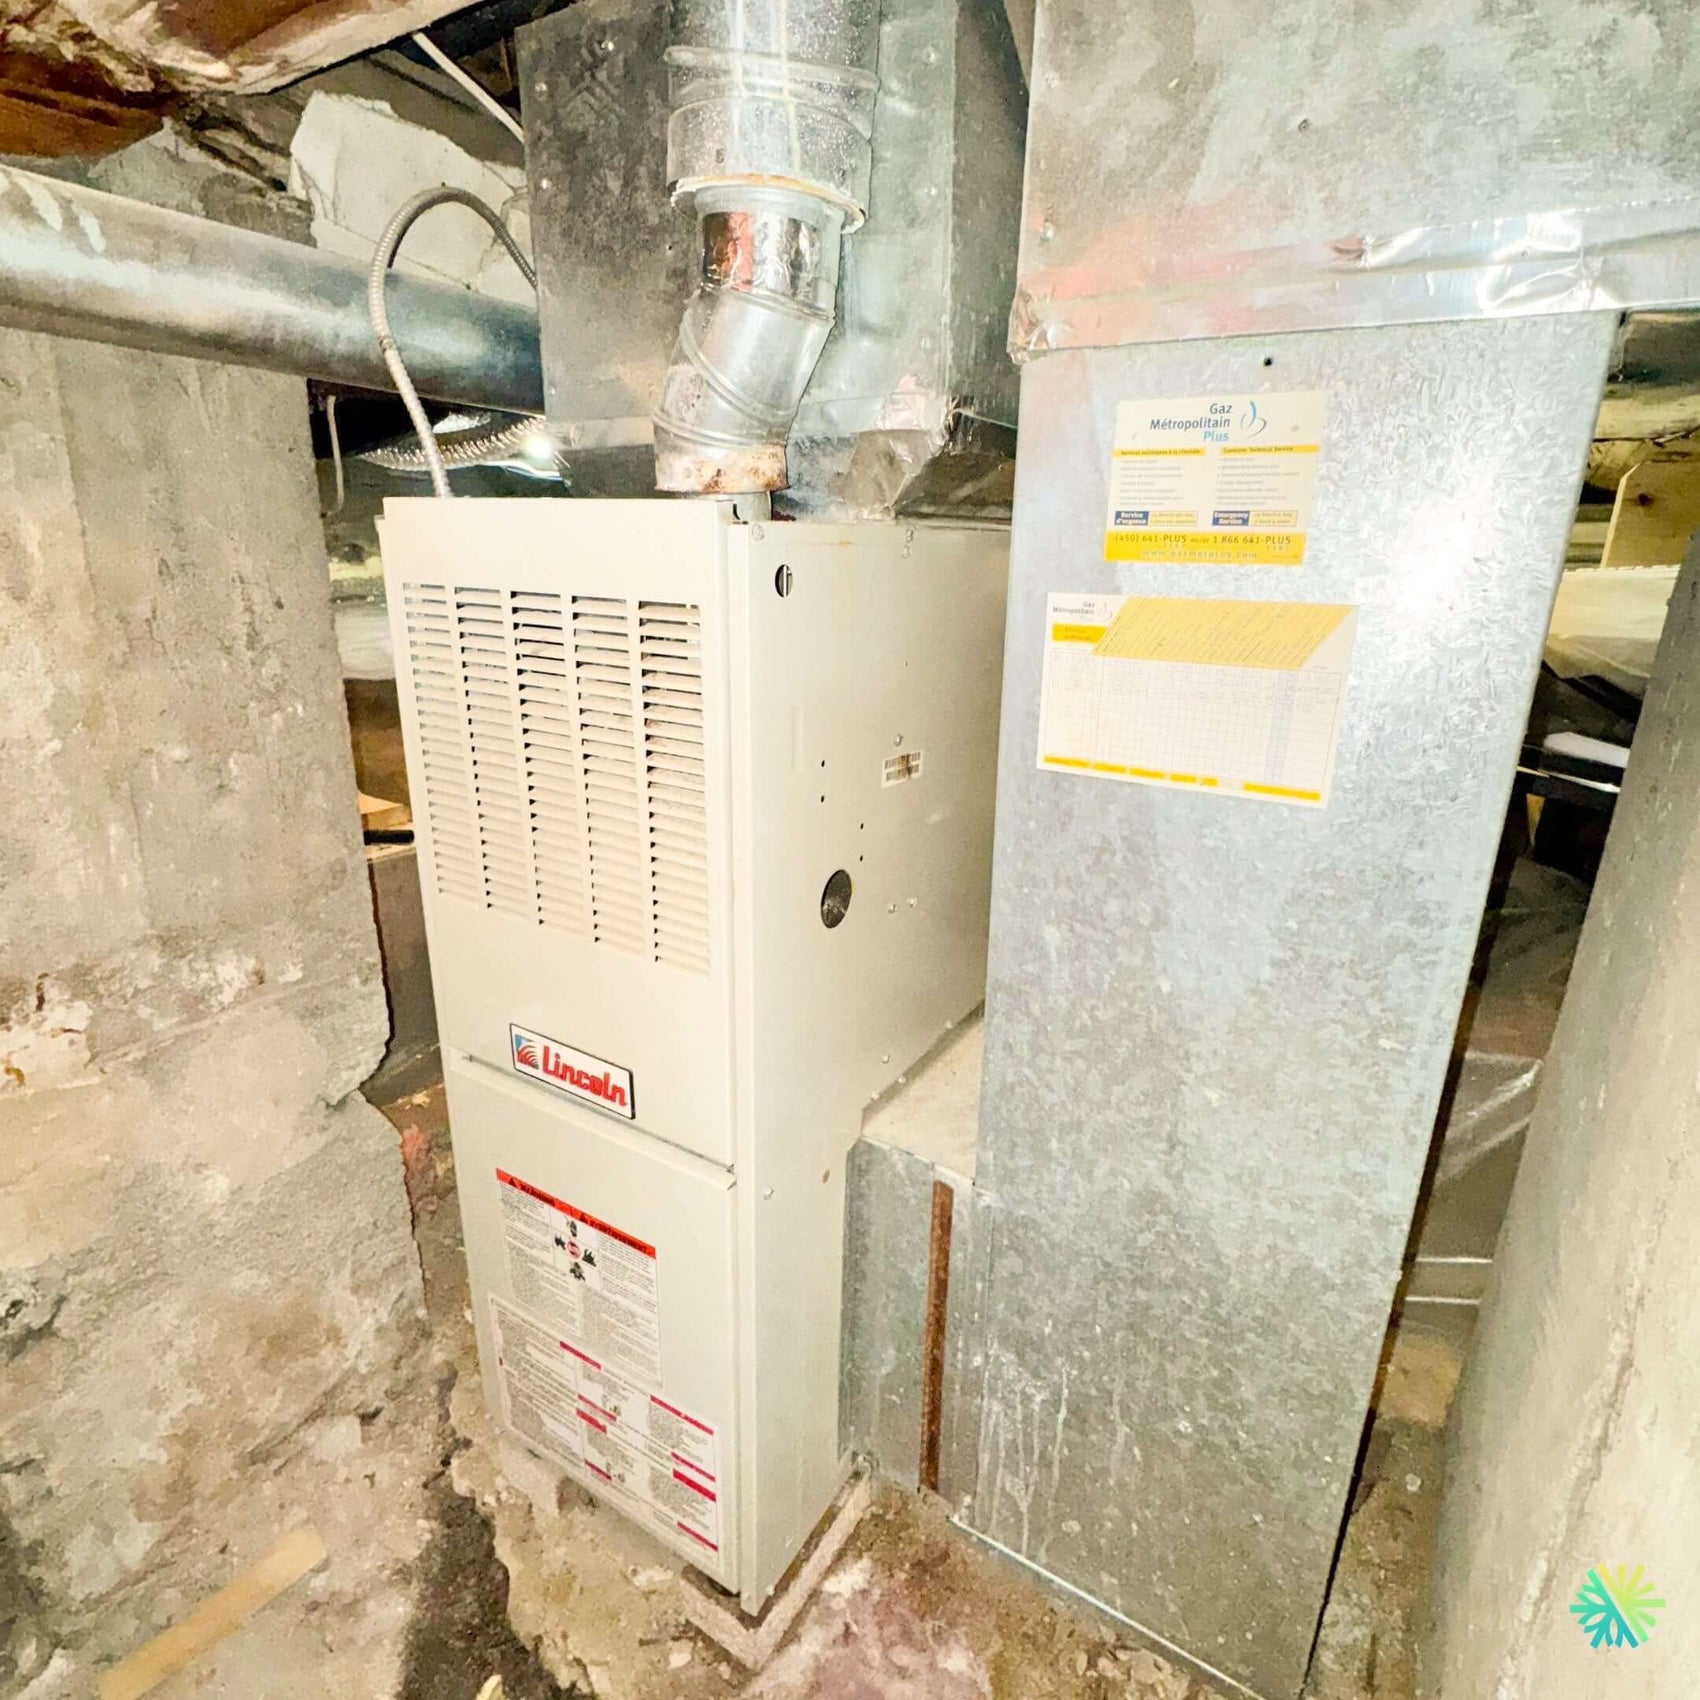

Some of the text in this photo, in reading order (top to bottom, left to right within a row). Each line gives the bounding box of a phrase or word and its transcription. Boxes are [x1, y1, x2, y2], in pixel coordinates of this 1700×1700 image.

[1209, 403, 1233, 415] Gaz
[1149, 416, 1231, 432] Métropolitain
[1203, 430, 1229, 442] Plus
[1115, 534, 1139, 543] (450)
[1142, 534, 1187, 543] 641-PLUS
[543, 1045, 628, 1107] Lincoln
